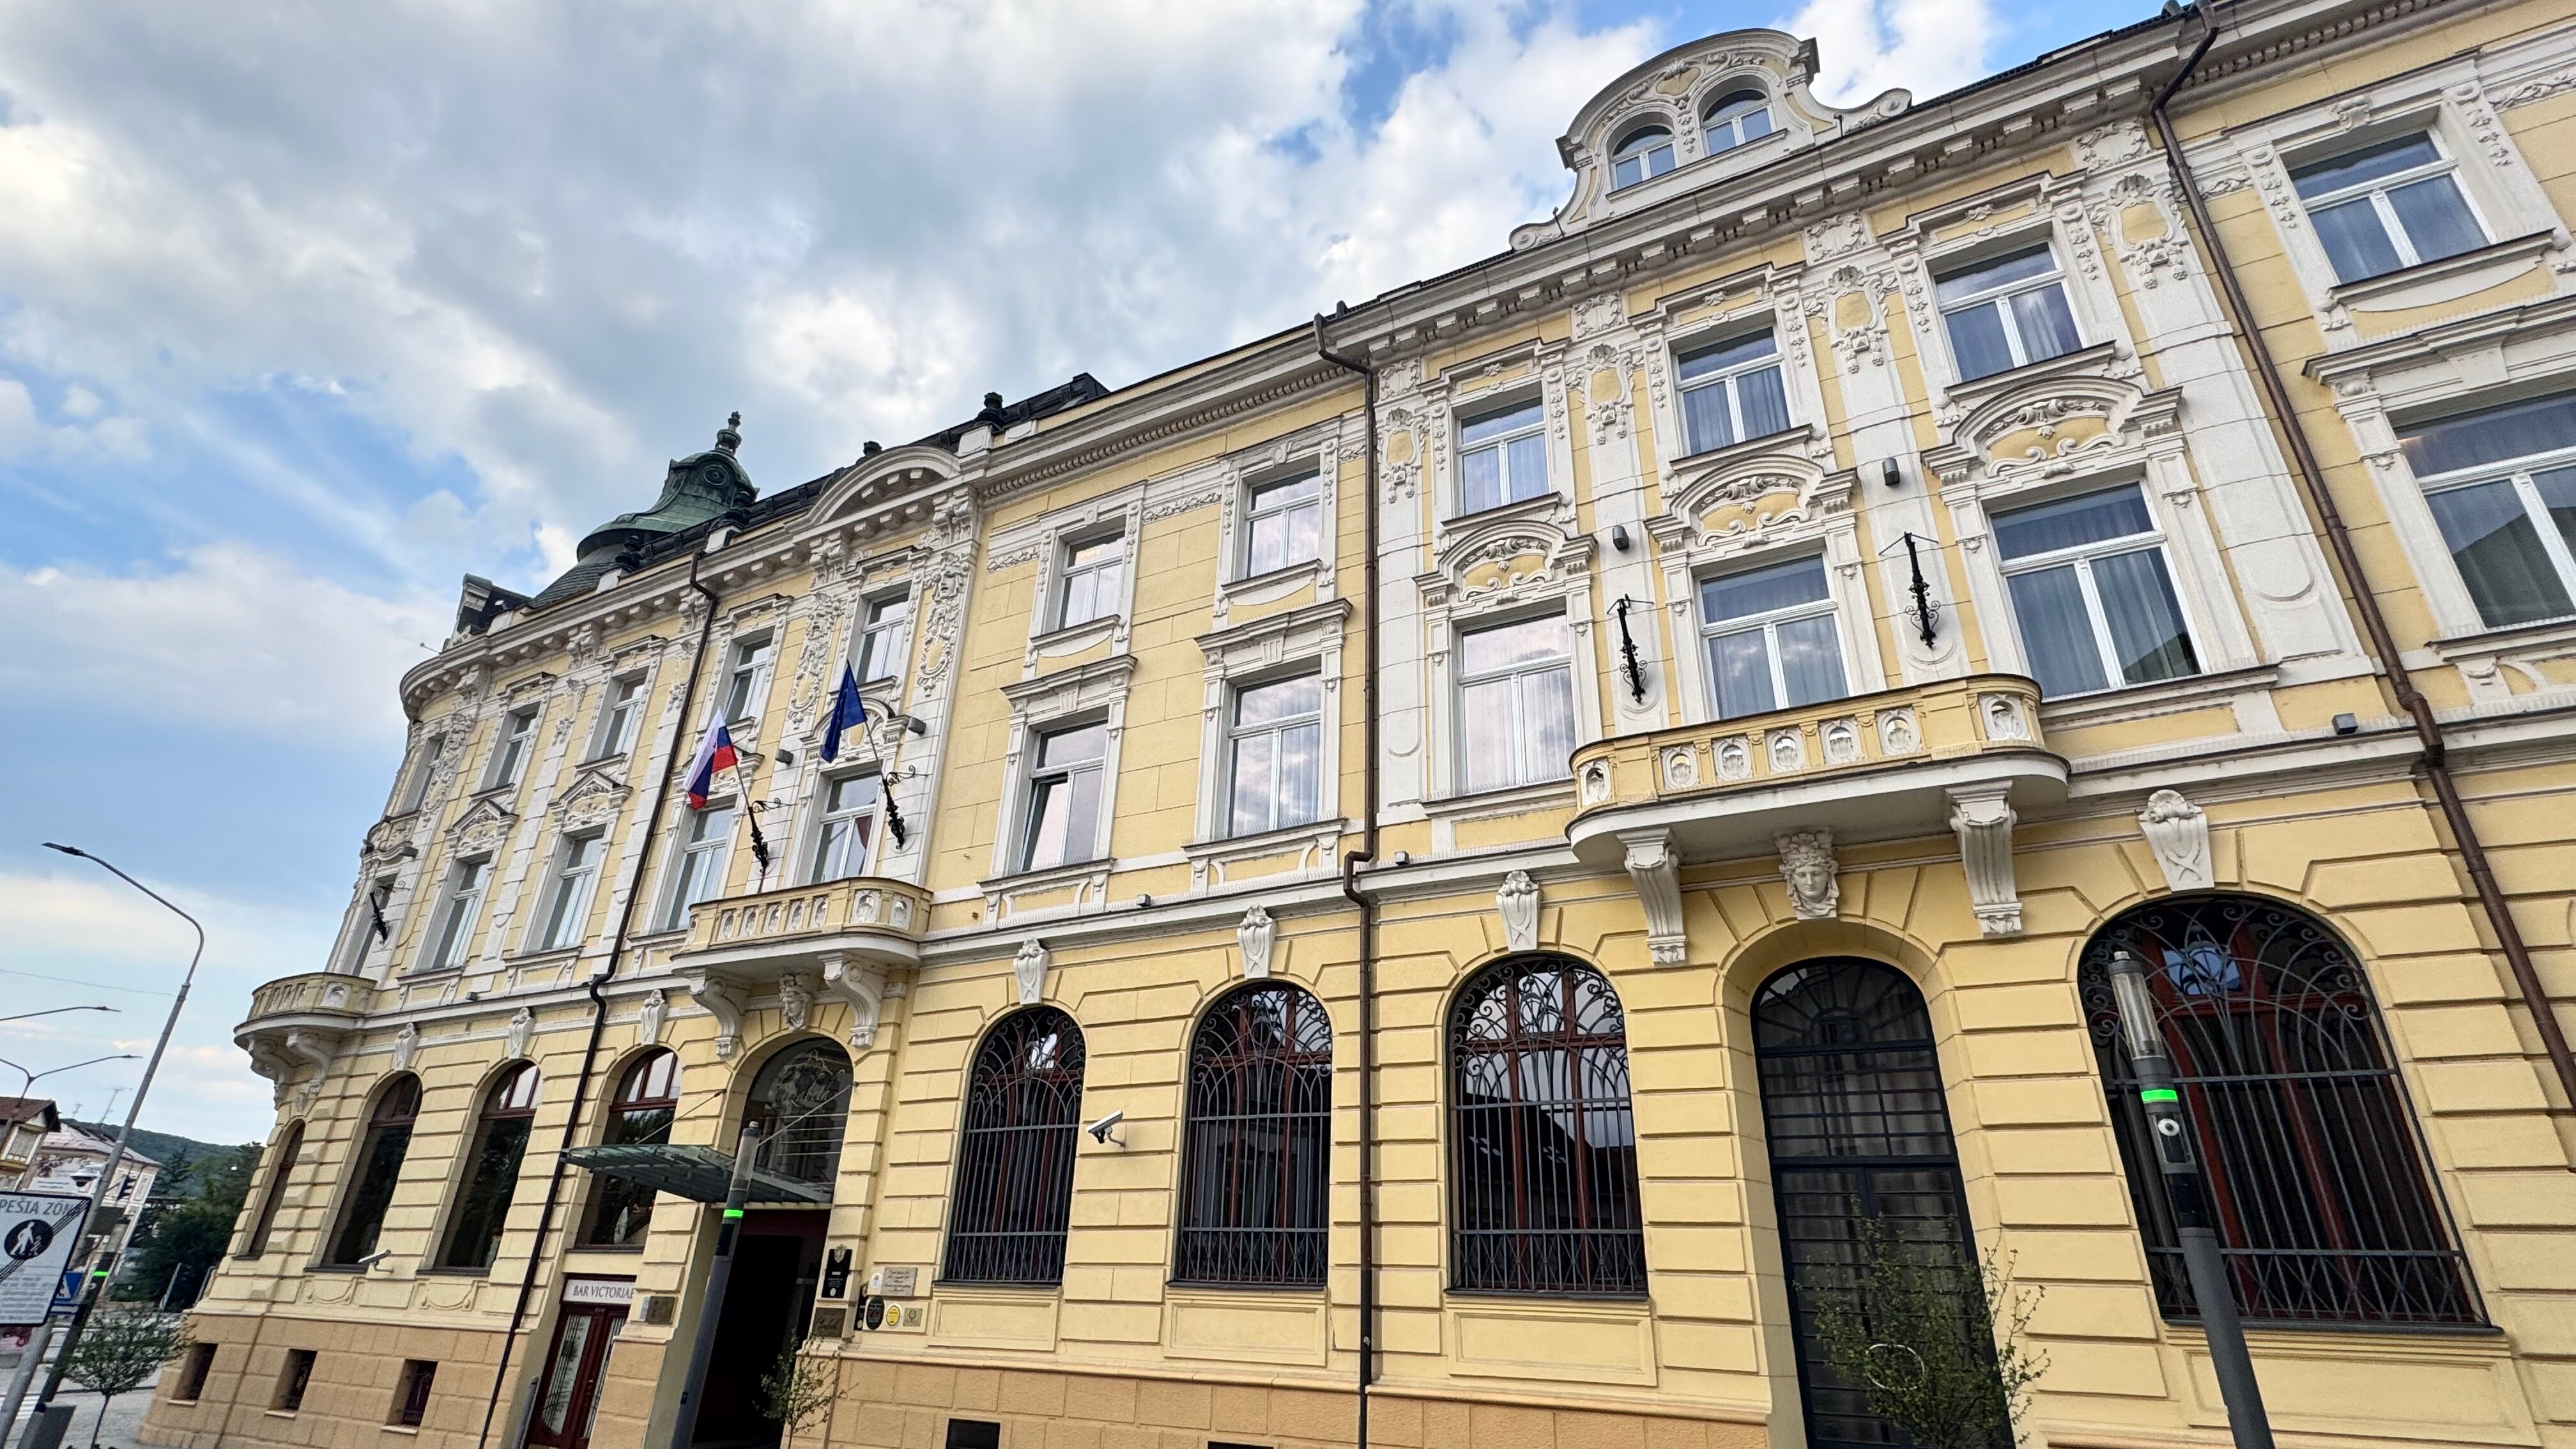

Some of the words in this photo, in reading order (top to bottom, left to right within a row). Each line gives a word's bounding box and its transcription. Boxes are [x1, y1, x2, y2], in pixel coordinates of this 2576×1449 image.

[0, 1197, 39, 1215] PEŠIA
[43, 1200, 81, 1216] ZÓN
[573, 1285, 589, 1297] BAR
